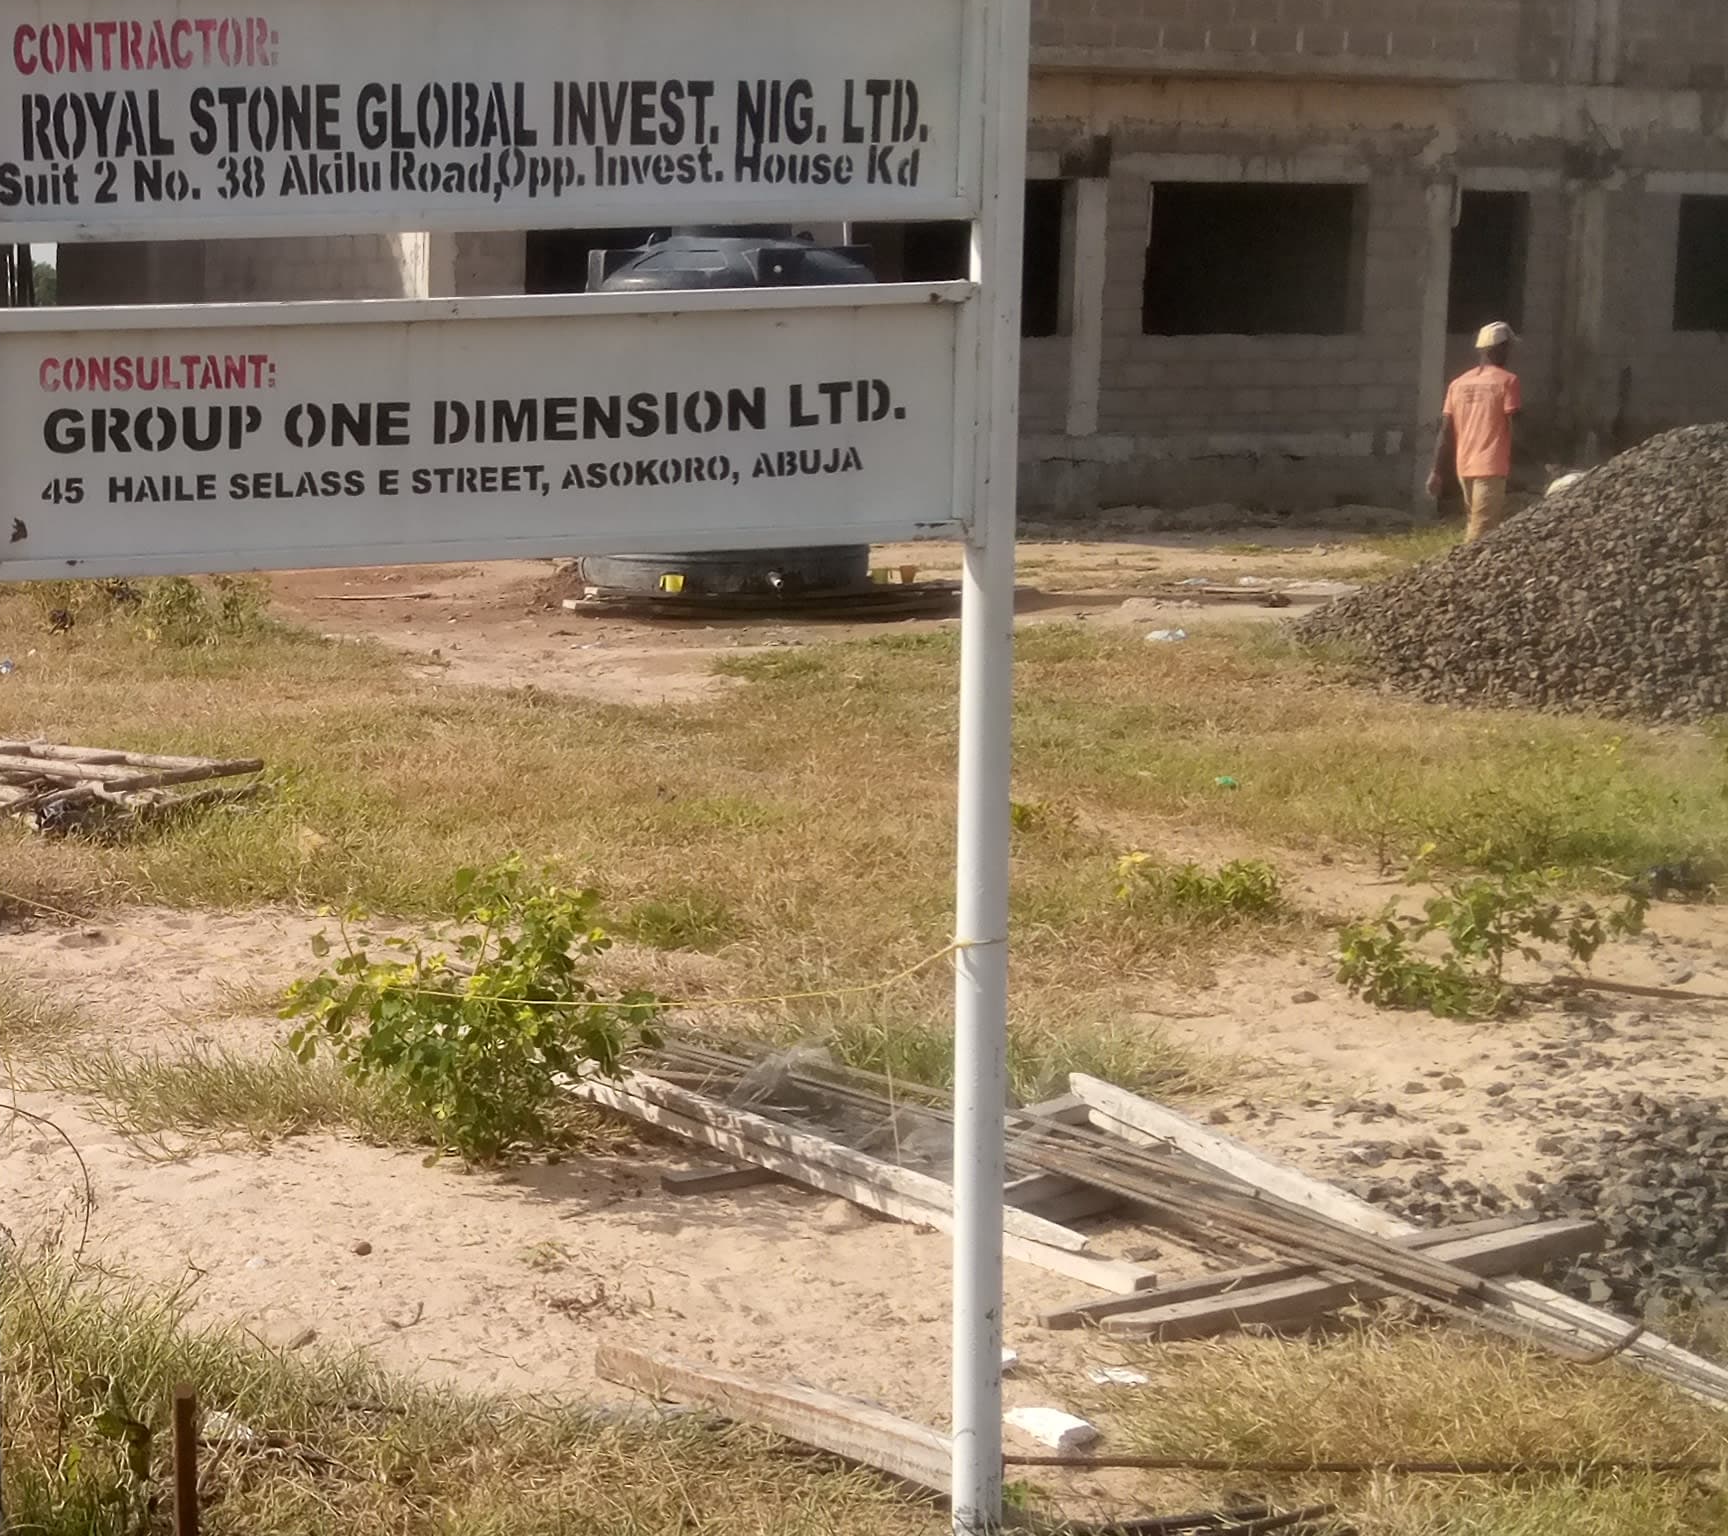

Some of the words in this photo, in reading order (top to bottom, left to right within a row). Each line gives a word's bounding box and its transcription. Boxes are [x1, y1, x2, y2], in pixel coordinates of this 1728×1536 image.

[13, 18, 279, 76] CONTRACTOR:
[22, 89, 174, 161] ROYAL
[190, 84, 341, 155] STONE
[357, 81, 537, 149] GLOBAL
[553, 80, 719, 146] INVEST.
[737, 79, 826, 145] NIG.
[843, 79, 928, 143] LTD.
[94, 161, 118, 204] 2
[134, 160, 201, 202] No.
[217, 156, 265, 199] 38
[280, 150, 381, 196] Akilu
[595, 144, 723, 186] Invest.
[735, 142, 853, 184] House
[39, 356, 276, 393] CONSULTANT:
[41, 407, 261, 454] GROUP
[284, 402, 409, 448] ONE
[434, 386, 767, 446] DIMENSION
[790, 379, 906, 427] LTD.
[41, 477, 84, 504] 45
[108, 473, 216, 503] HAILE
[412, 465, 550, 495] STREET,
[561, 451, 738, 491] ASOKORO,
[752, 447, 862, 477] ABUJA
